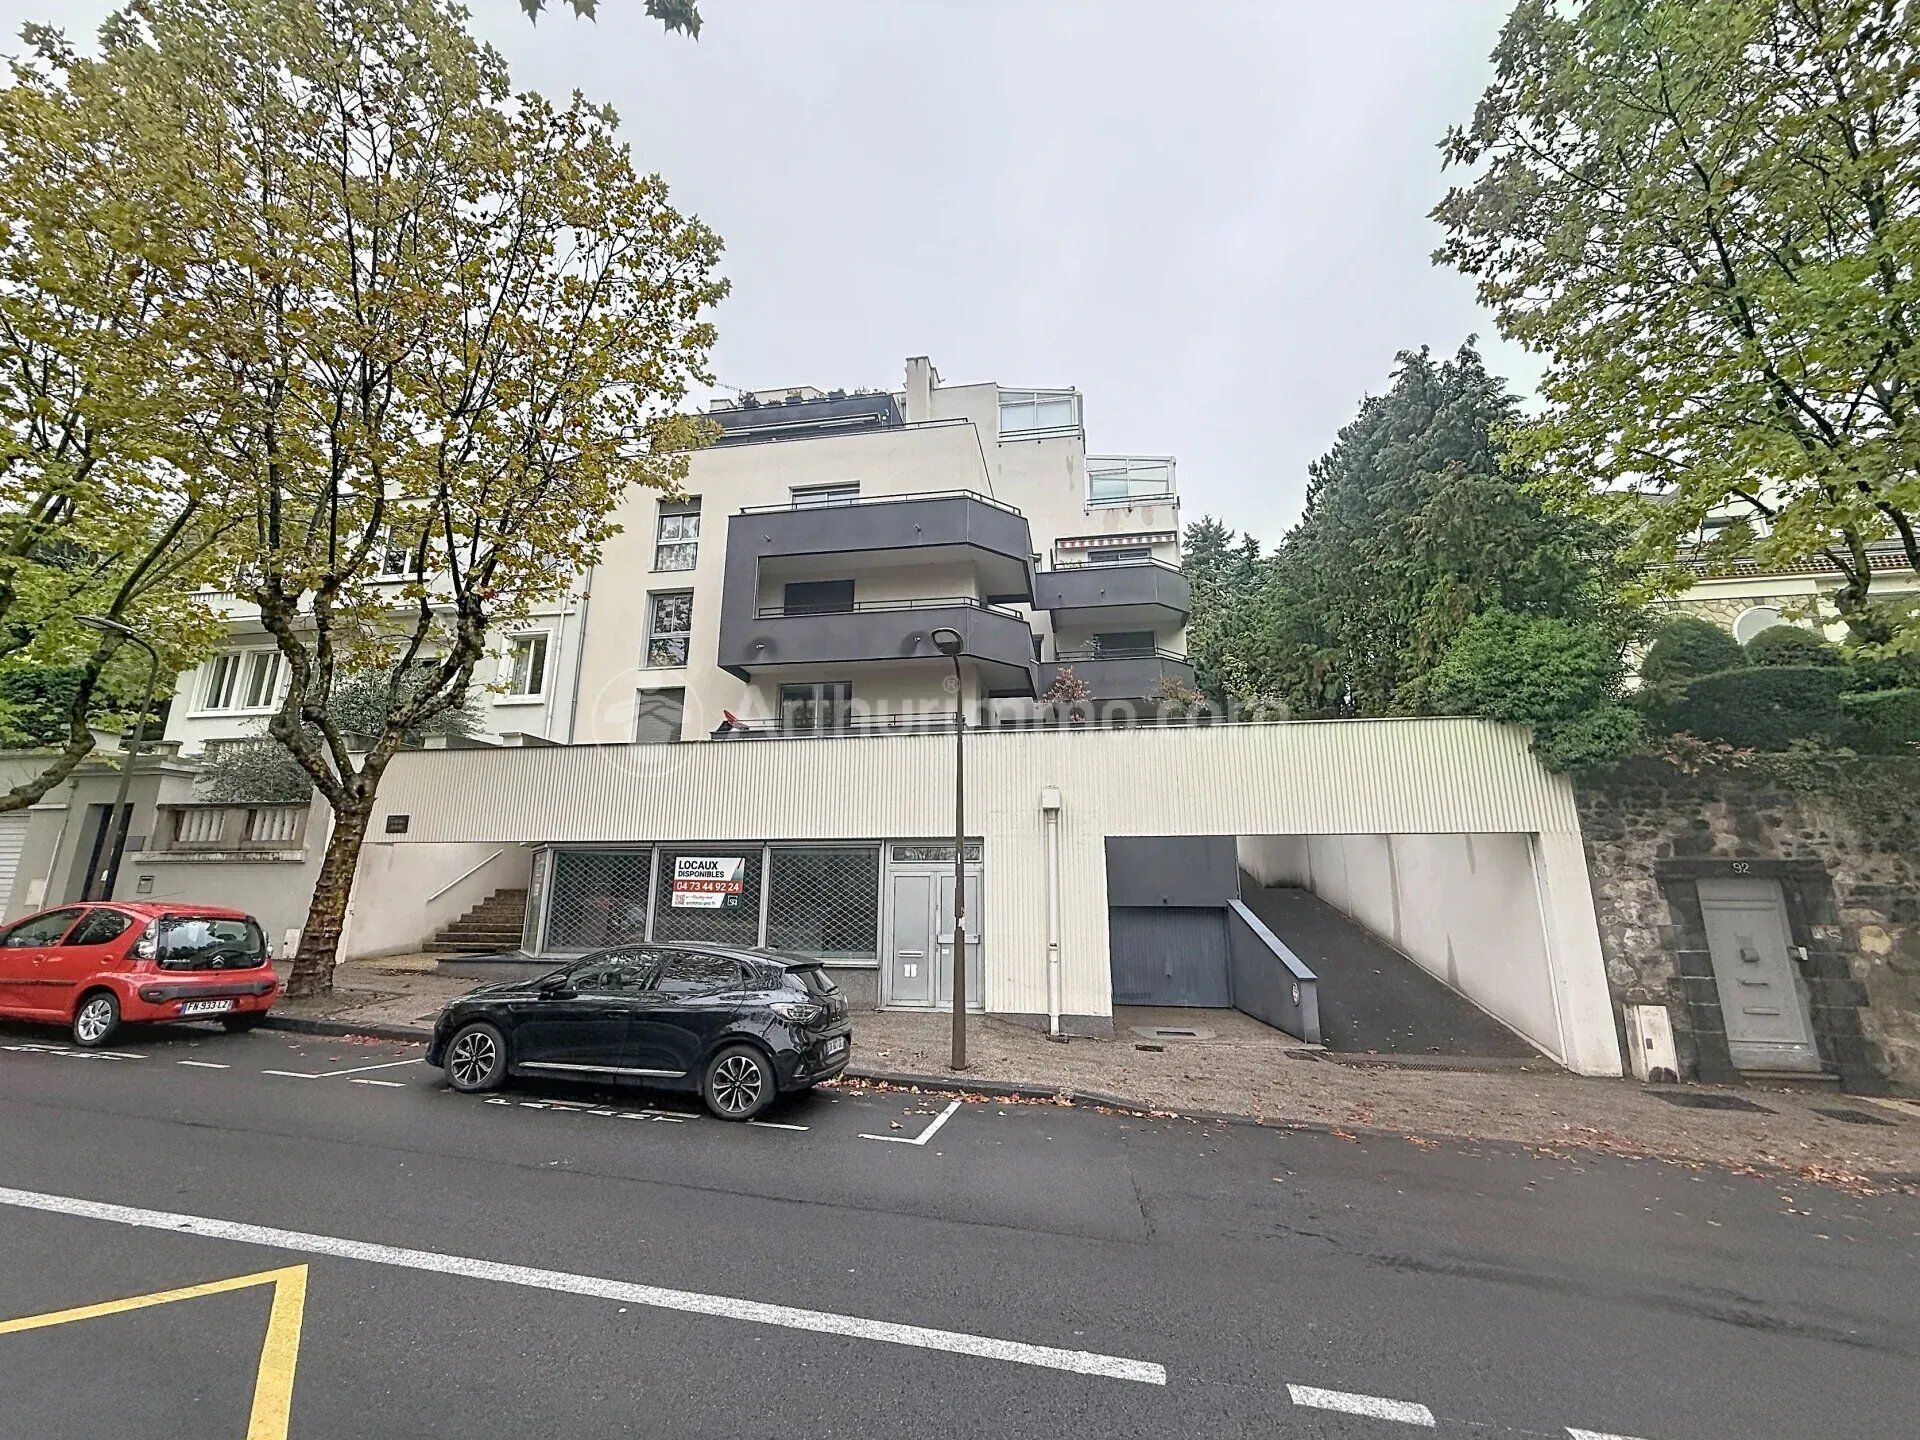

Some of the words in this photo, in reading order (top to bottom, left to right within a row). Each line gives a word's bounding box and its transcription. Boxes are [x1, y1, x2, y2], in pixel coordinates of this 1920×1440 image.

[678, 860, 718, 870] LOCAUX
[1732, 862, 1751, 874] 92
[677, 870, 725, 878] DISPONIBLES
[676, 881, 688, 891] 04
[689, 882, 701, 891] 73
[701, 882, 714, 891] 44
[715, 883, 727, 892] 92
[727, 883, 740, 892] 24
